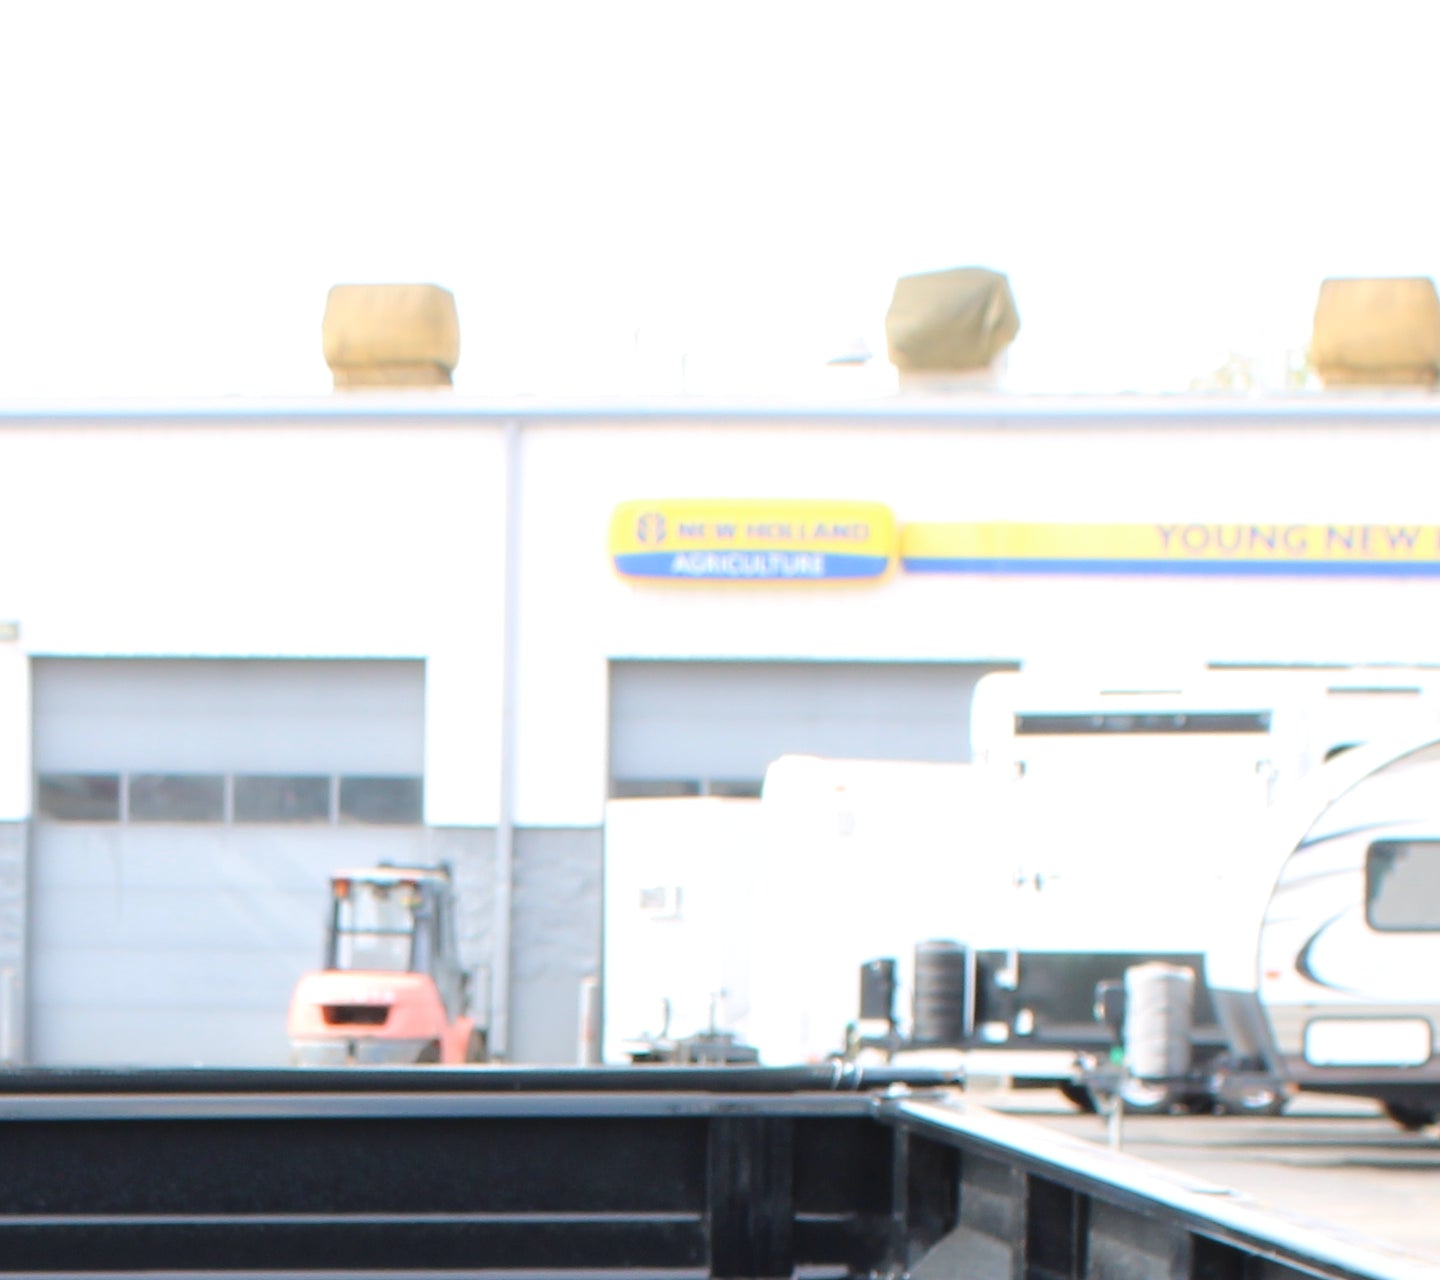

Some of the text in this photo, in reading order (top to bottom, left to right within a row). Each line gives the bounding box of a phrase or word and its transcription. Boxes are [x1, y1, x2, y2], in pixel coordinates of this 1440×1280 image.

[679, 522, 869, 540] NEW HOLLAND
[1157, 524, 1308, 553] YOUNG
[1326, 524, 1420, 554] NEW
[673, 551, 824, 573] AGRICULTURE
